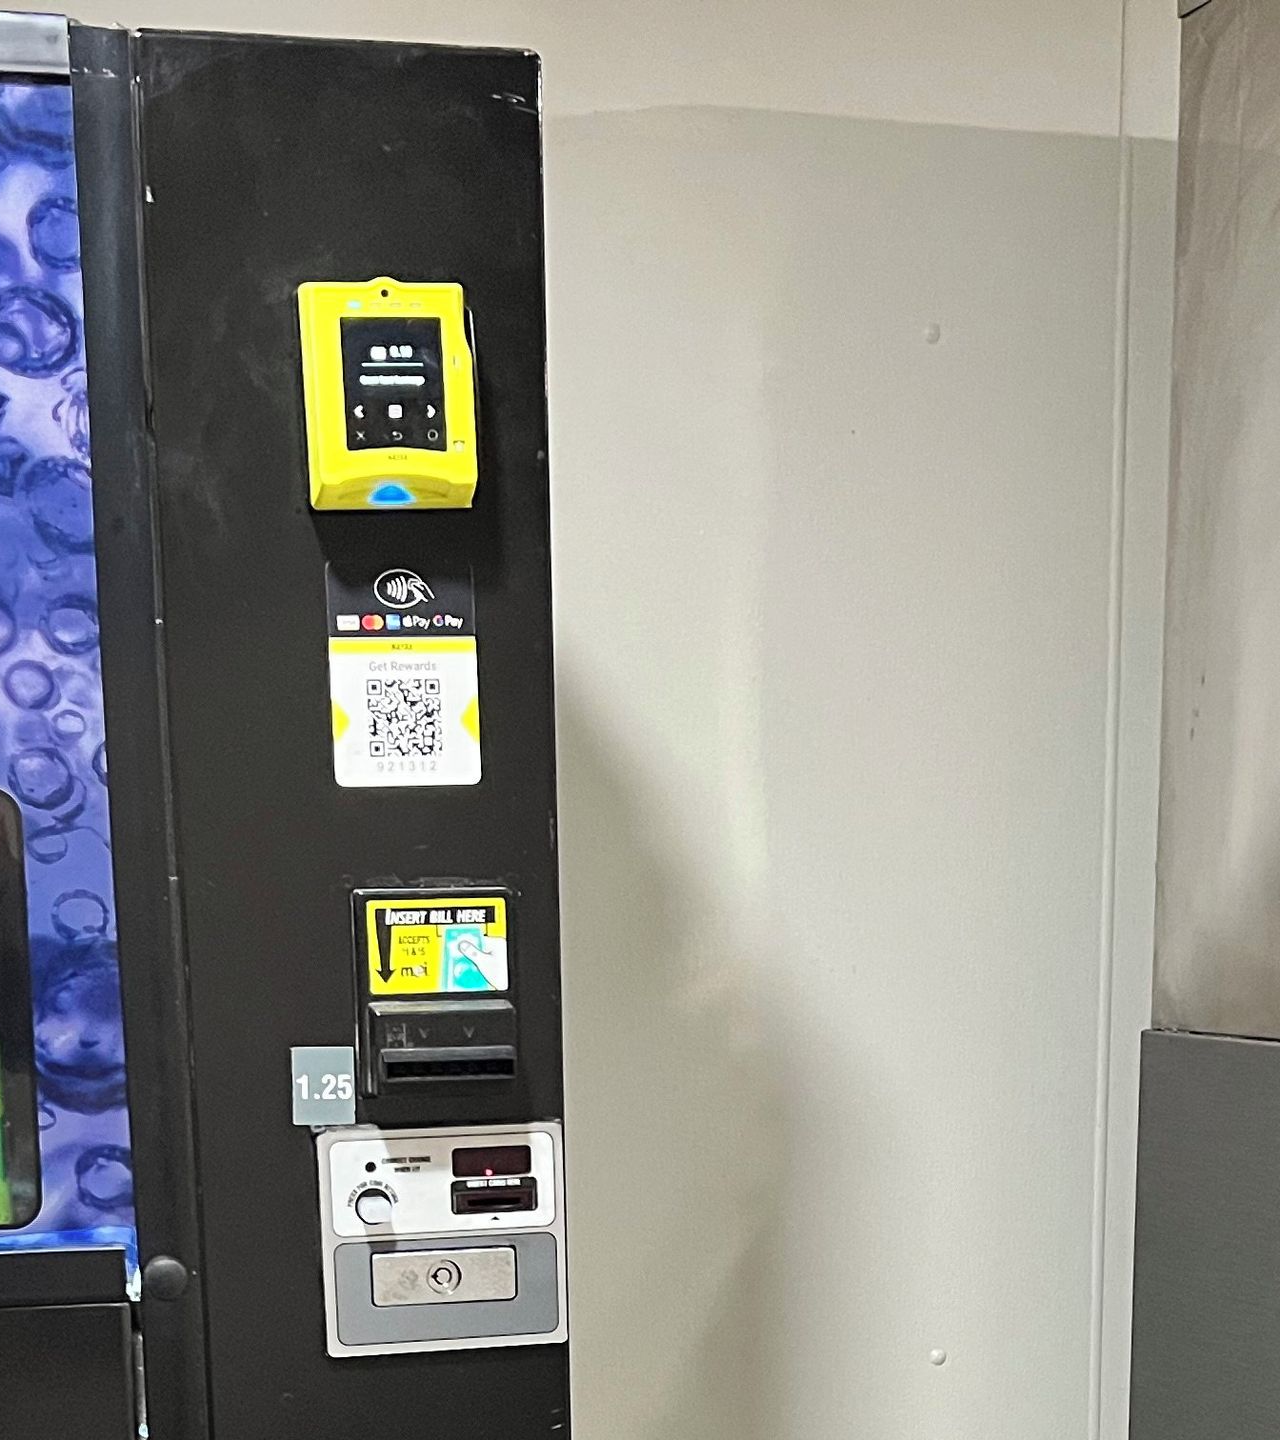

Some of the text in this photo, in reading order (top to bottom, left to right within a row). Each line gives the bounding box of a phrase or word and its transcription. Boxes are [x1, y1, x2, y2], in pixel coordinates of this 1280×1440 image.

[445, 614, 463, 629] Pay
[369, 661, 437, 671] Get Rewards
[377, 761, 438, 772] 921312
[385, 908, 486, 925] INSERT BILL HERE
[295, 1073, 353, 1100] 1.25
